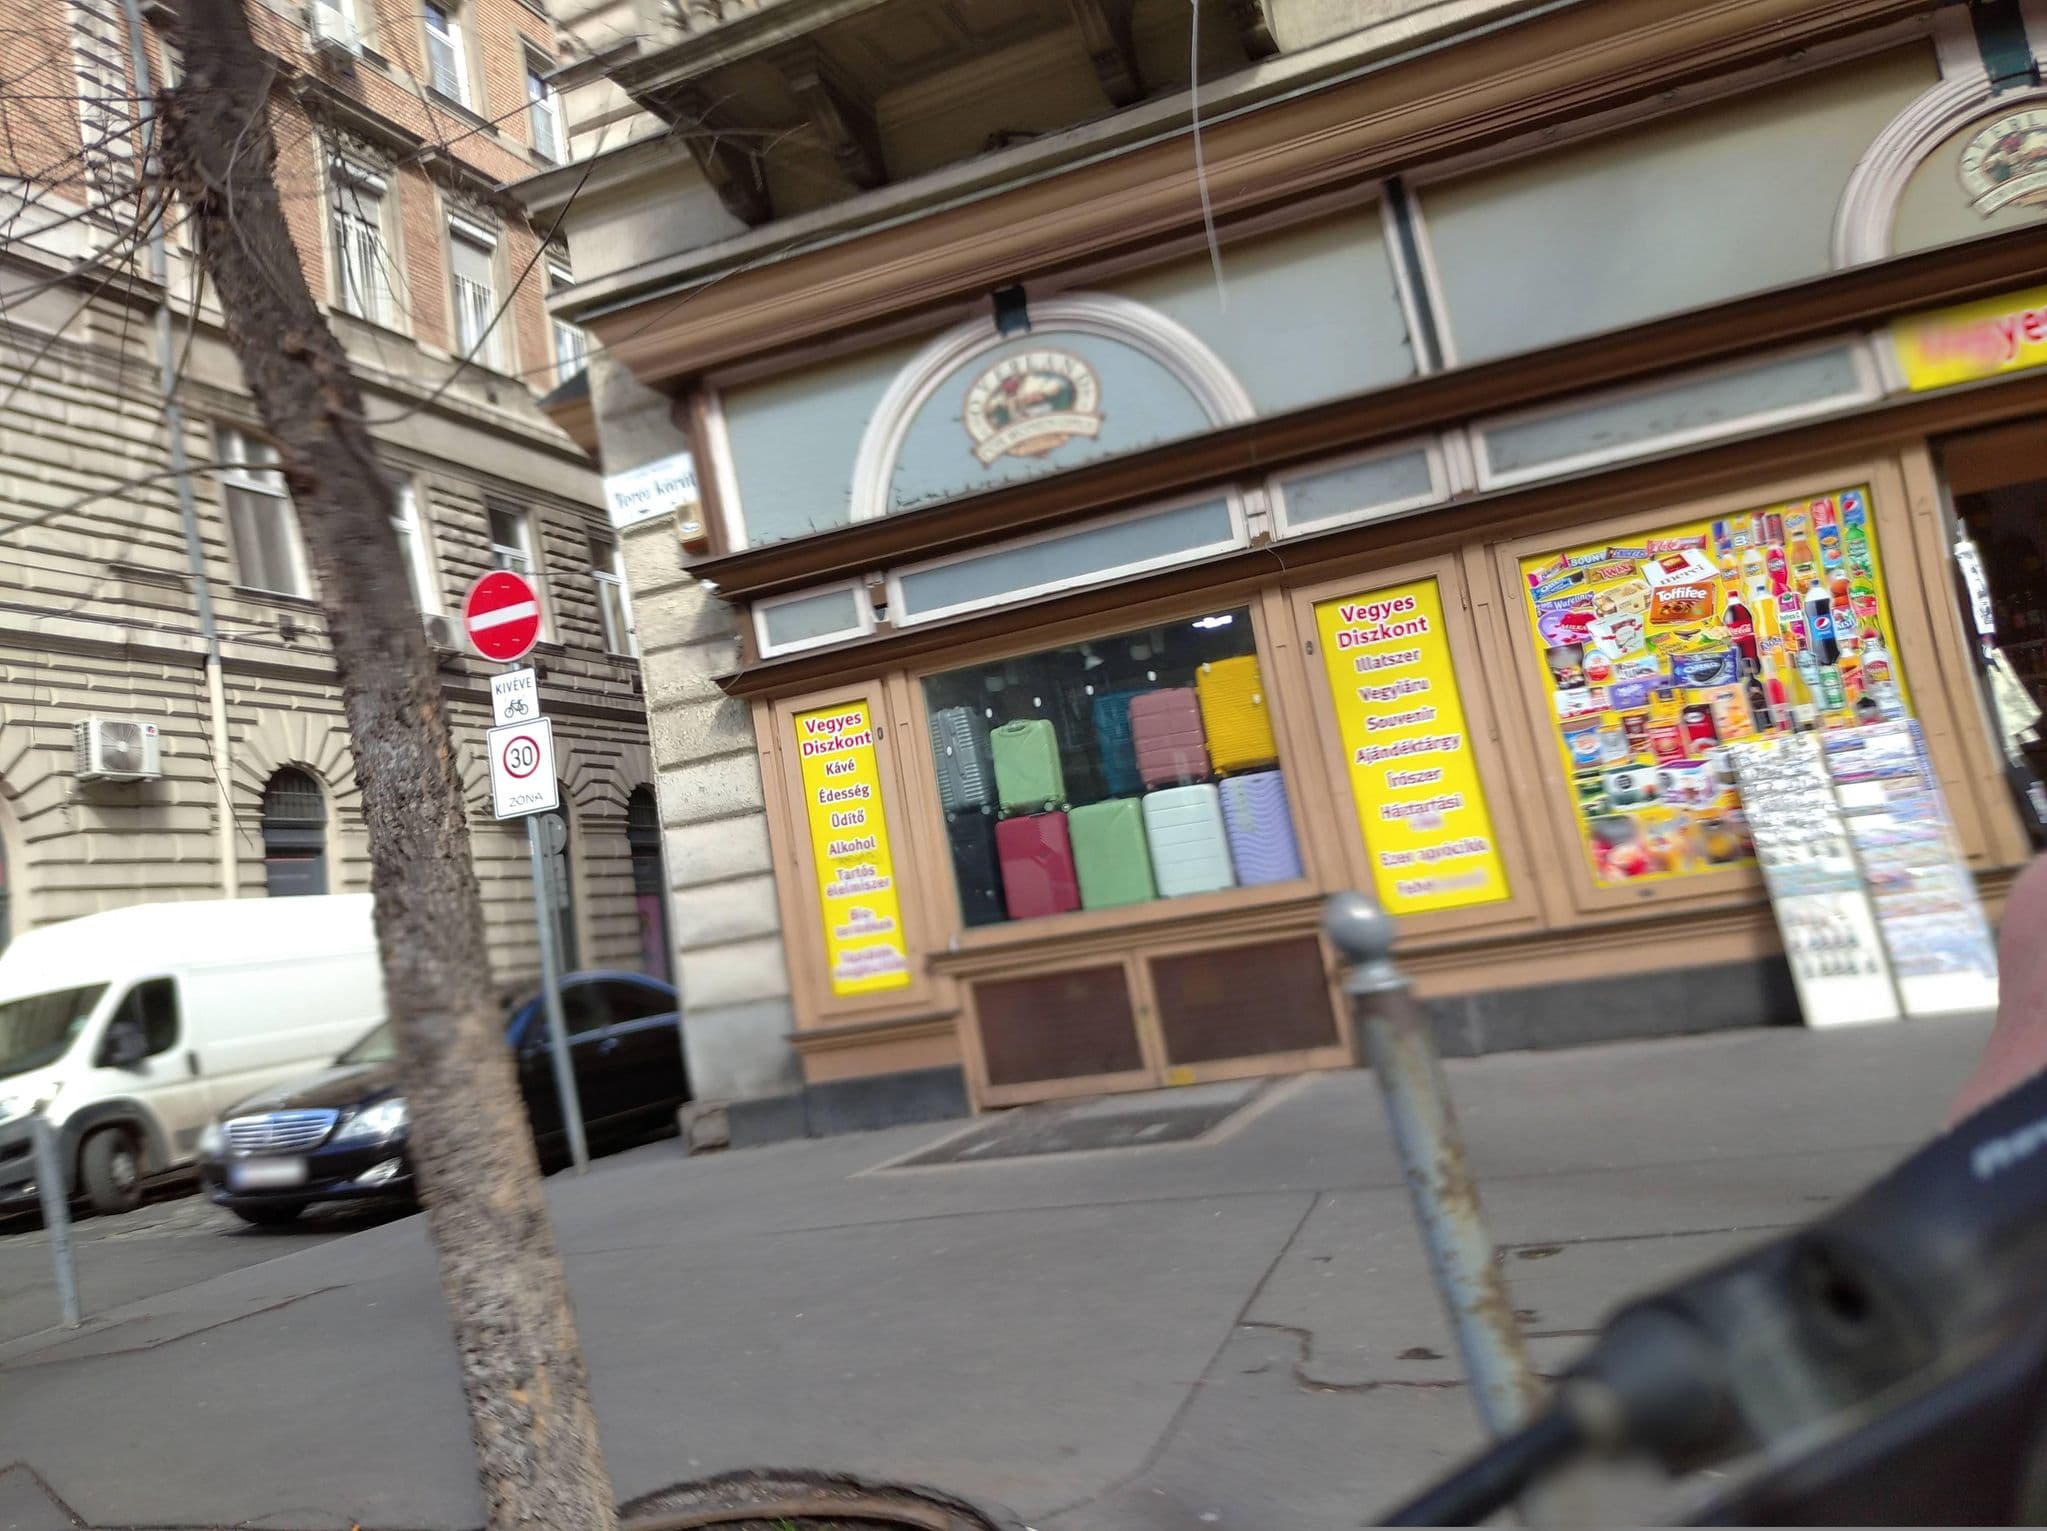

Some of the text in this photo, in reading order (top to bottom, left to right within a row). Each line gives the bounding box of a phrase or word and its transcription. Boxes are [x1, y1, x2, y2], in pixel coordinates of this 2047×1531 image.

[1655, 586, 1708, 602] Toffifee
[1340, 597, 1415, 622] Vegyes
[1337, 617, 1428, 648] Diszkont
[1355, 649, 1420, 672] Illatszer
[495, 677, 533, 695] KIVÉVE
[805, 713, 862, 734] Vegyes
[1367, 707, 1436, 731] Souvenir
[802, 731, 872, 756] Diszkont
[1355, 735, 1461, 765] Ajándéktárgy
[510, 745, 533, 769] 30
[825, 759, 855, 776] Kávé
[819, 784, 870, 803] Édesség
[831, 809, 865, 828] Üdítő
[829, 836, 876, 855] Alkohol
